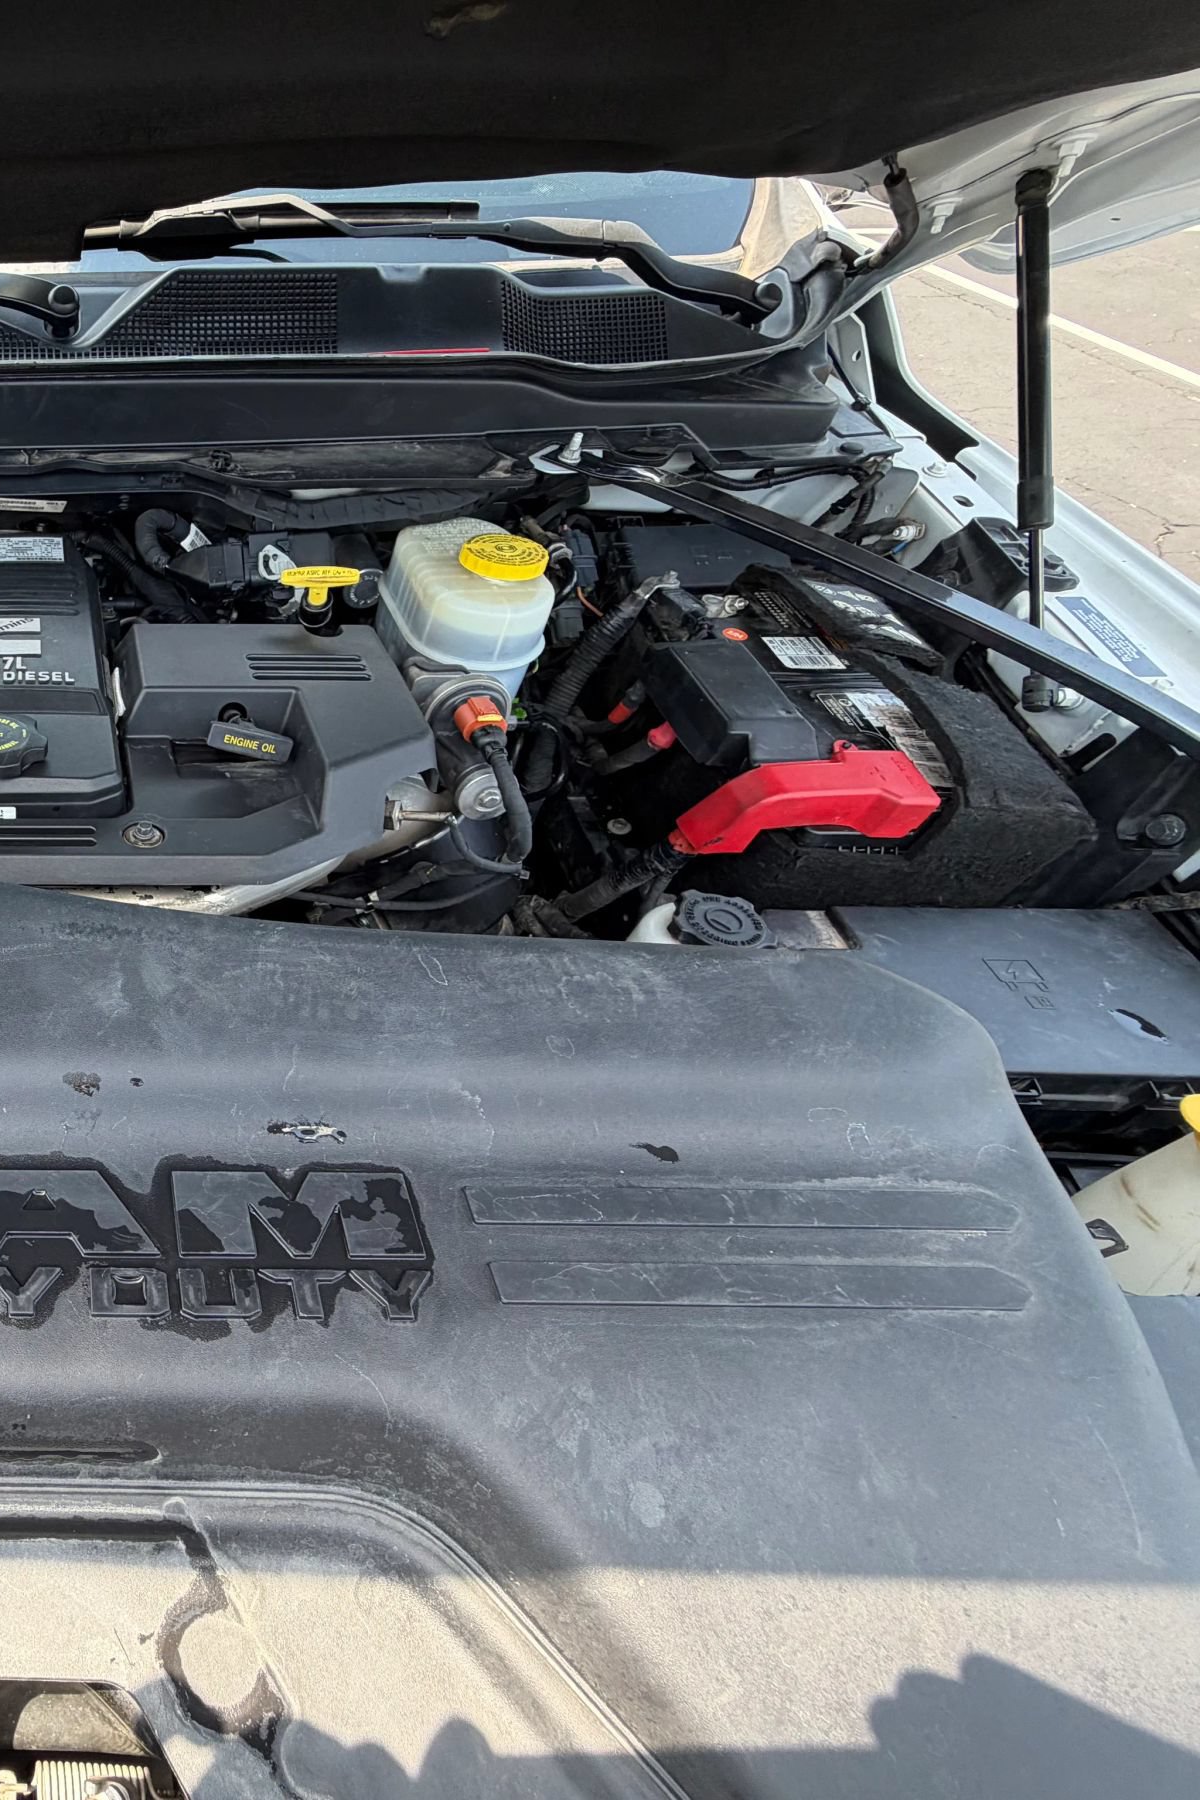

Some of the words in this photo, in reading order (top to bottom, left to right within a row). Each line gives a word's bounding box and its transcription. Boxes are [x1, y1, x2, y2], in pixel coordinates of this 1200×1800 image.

[3, 671, 76, 684] DIESEL
[223, 734, 260, 750] ENGINE
[261, 743, 277, 754] OIL
[89, 1266, 431, 1323] DUTY
